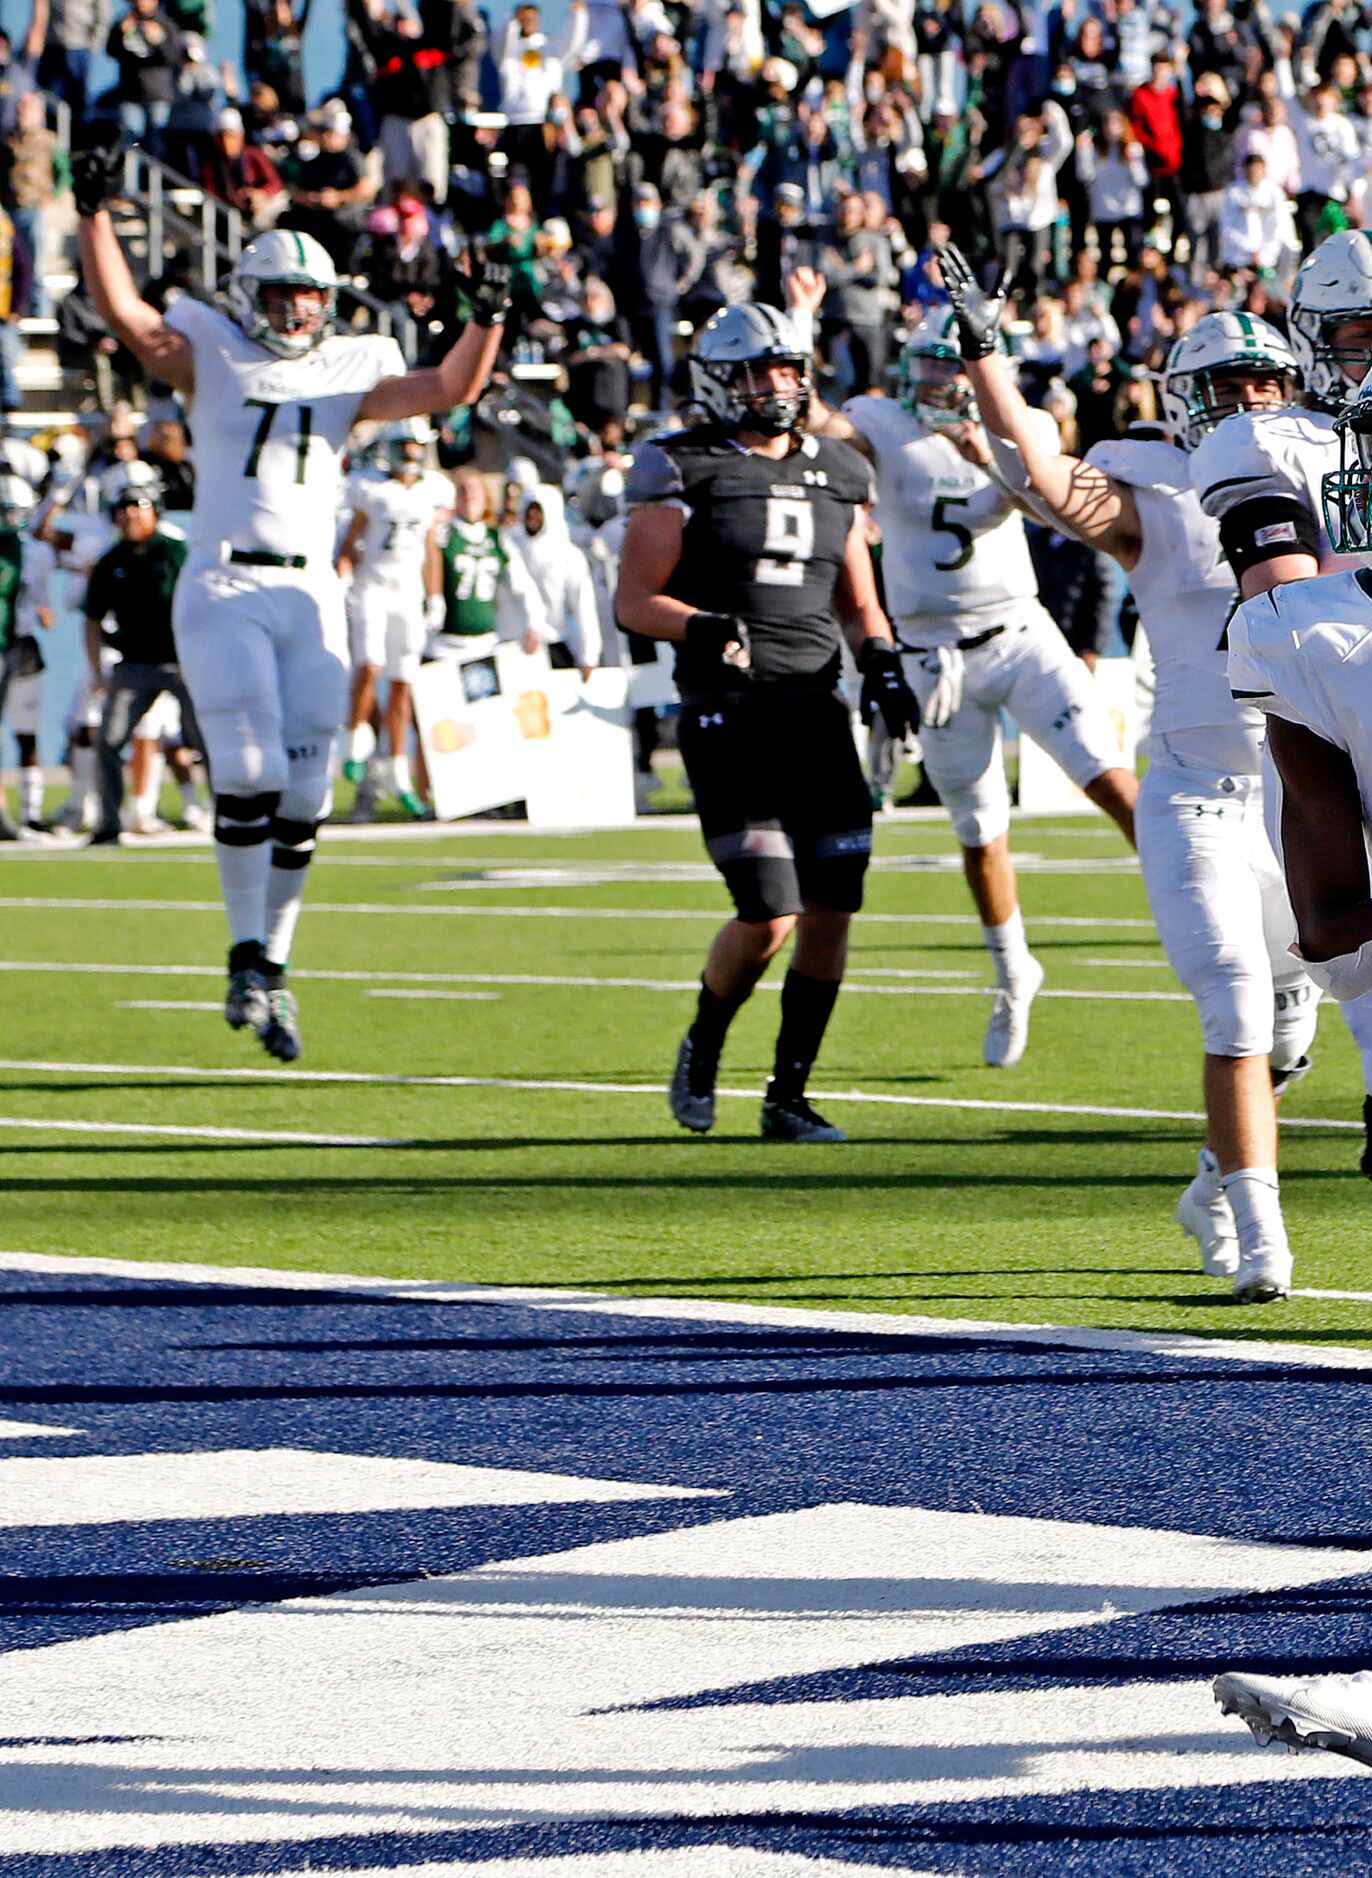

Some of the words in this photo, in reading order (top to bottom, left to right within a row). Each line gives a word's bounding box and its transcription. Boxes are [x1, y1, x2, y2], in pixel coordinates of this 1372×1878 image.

[243, 398, 312, 485] 71
[755, 498, 815, 587] 9
[931, 495, 973, 571] 5
